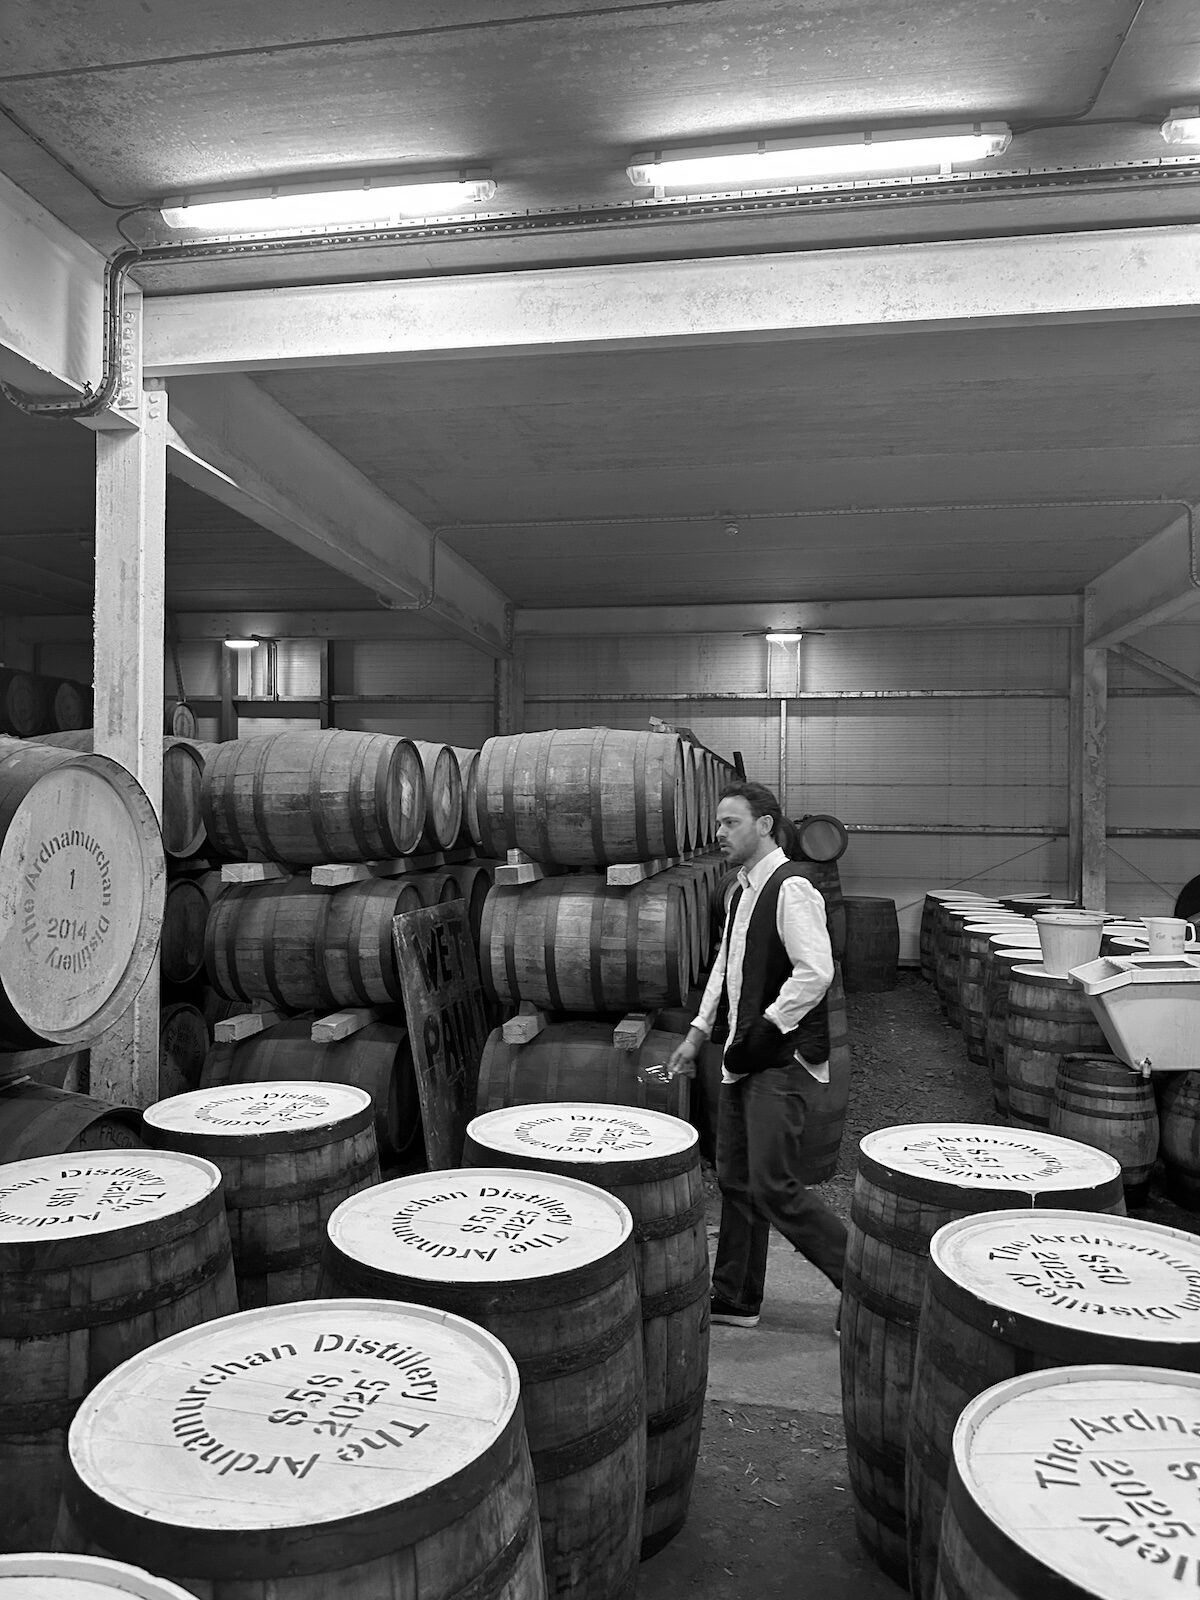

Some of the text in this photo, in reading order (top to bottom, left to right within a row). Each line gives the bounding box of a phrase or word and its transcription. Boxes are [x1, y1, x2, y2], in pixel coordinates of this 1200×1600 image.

[69, 869, 76, 890] 1
[21, 830, 112, 974] The Ardnamurchan Distillery
[47, 918, 87, 941] 2014
[411, 920, 465, 994] WET
[566, 1126, 594, 1143] S60
[571, 1115, 652, 1136] Distillery
[596, 1128, 625, 1146] 2025
[611, 1141, 653, 1151] The
[903, 1136, 1069, 1181] The Ardnamurchan Distillery
[937, 1146, 973, 1168] 2025
[61, 1167, 166, 1186] Distillery
[97, 1180, 135, 1206] 2025
[111, 1192, 167, 1212] The
[392, 1187, 573, 1262] The Ardnamurchan Distillery
[460, 1206, 508, 1233] S59
[493, 1210, 541, 1240] 2025
[989, 1240, 1031, 1261] The
[1031, 1251, 1085, 1289] 2025
[1078, 1254, 1133, 1285] S50
[1005, 1272, 1182, 1320] Distillery
[172, 1334, 438, 1479] The Ardnamurchan Distillery
[313, 1378, 391, 1438] 2025
[1034, 1438, 1085, 1489] The
[1089, 1460, 1196, 1536] 2025
